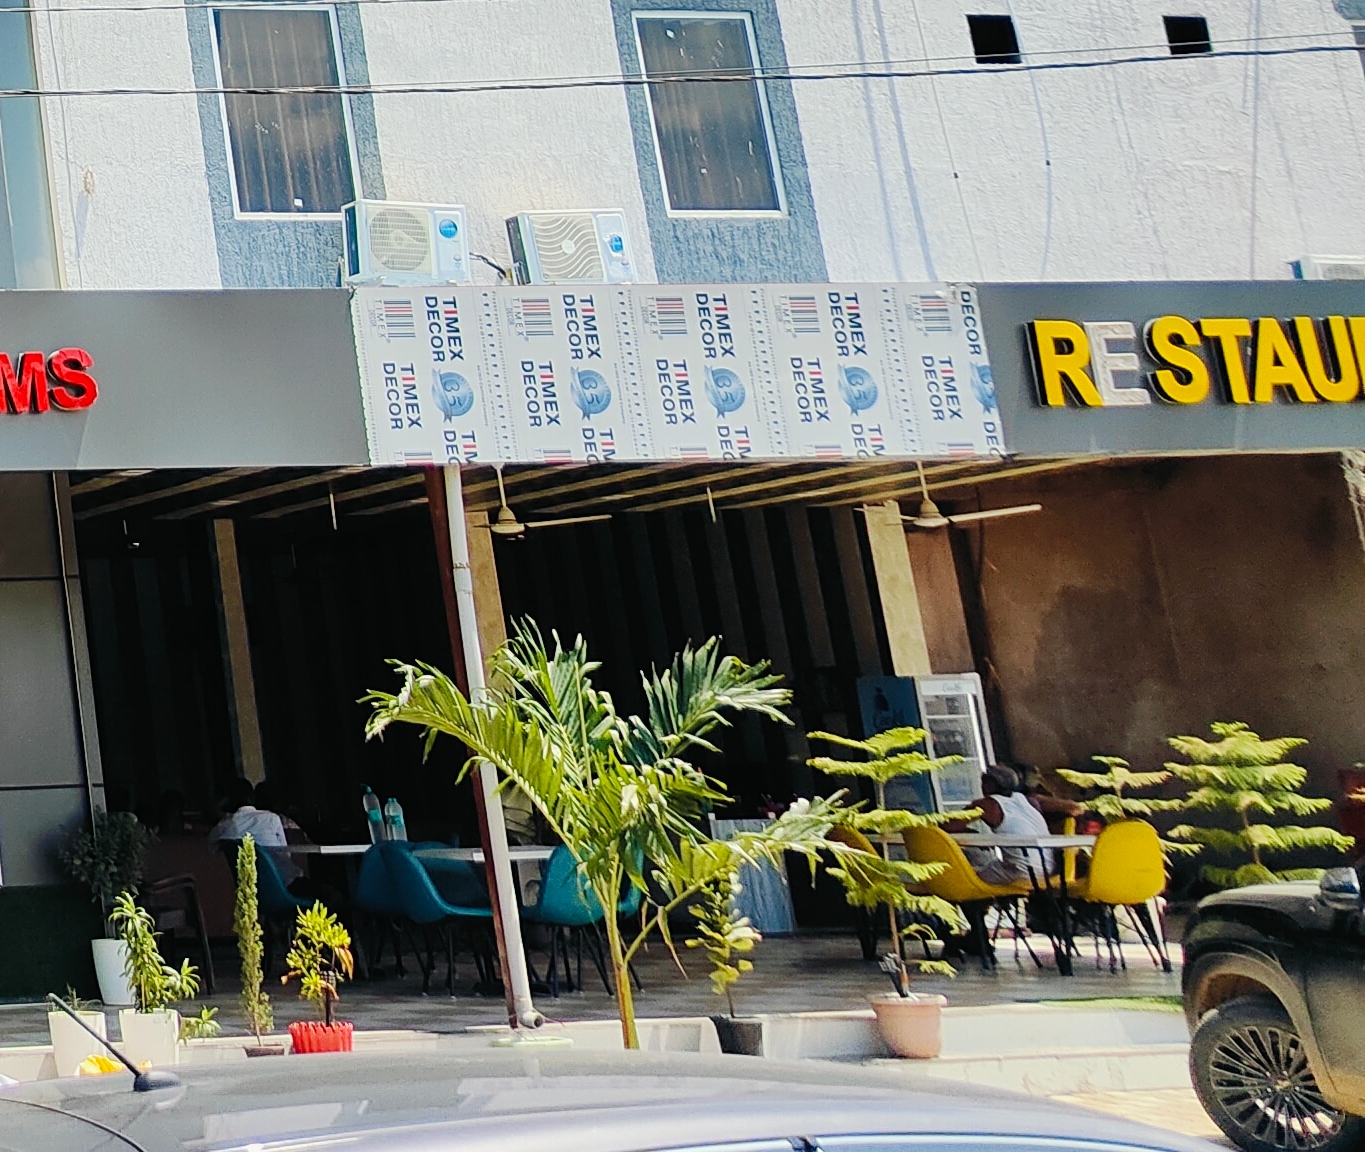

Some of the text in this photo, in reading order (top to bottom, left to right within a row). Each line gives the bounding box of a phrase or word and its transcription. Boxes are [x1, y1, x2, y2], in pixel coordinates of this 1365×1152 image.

[425, 296, 446, 362] DECOR
[443, 296, 464, 361] TIMEX
[562, 294, 584, 360] DECOR
[579, 294, 602, 359] TIMEX
[696, 293, 717, 359] DECOR
[713, 293, 736, 358] TIMEX
[828, 292, 849, 357] DECOR
[845, 292, 868, 357] TIMEX
[961, 291, 981, 355] DECOR
[443, 380, 461, 407] 35
[521, 360, 542, 427] DECOR
[539, 361, 561, 426] TIMEX
[582, 378, 600, 405] 35
[656, 359, 678, 425] DECOR
[673, 359, 696, 424] TIMEX
[716, 376, 734, 402] 35
[790, 357, 812, 423] DECOR
[807, 357, 831, 422] TIMEX
[848, 374, 869, 401] 35
[921, 356, 945, 421] DECOR
[939, 356, 963, 420] TIMEX
[1023, 315, 1365, 407] RESTAU
[383, 362, 403, 429] DECOR
[400, 362, 422, 428] TIMEX
